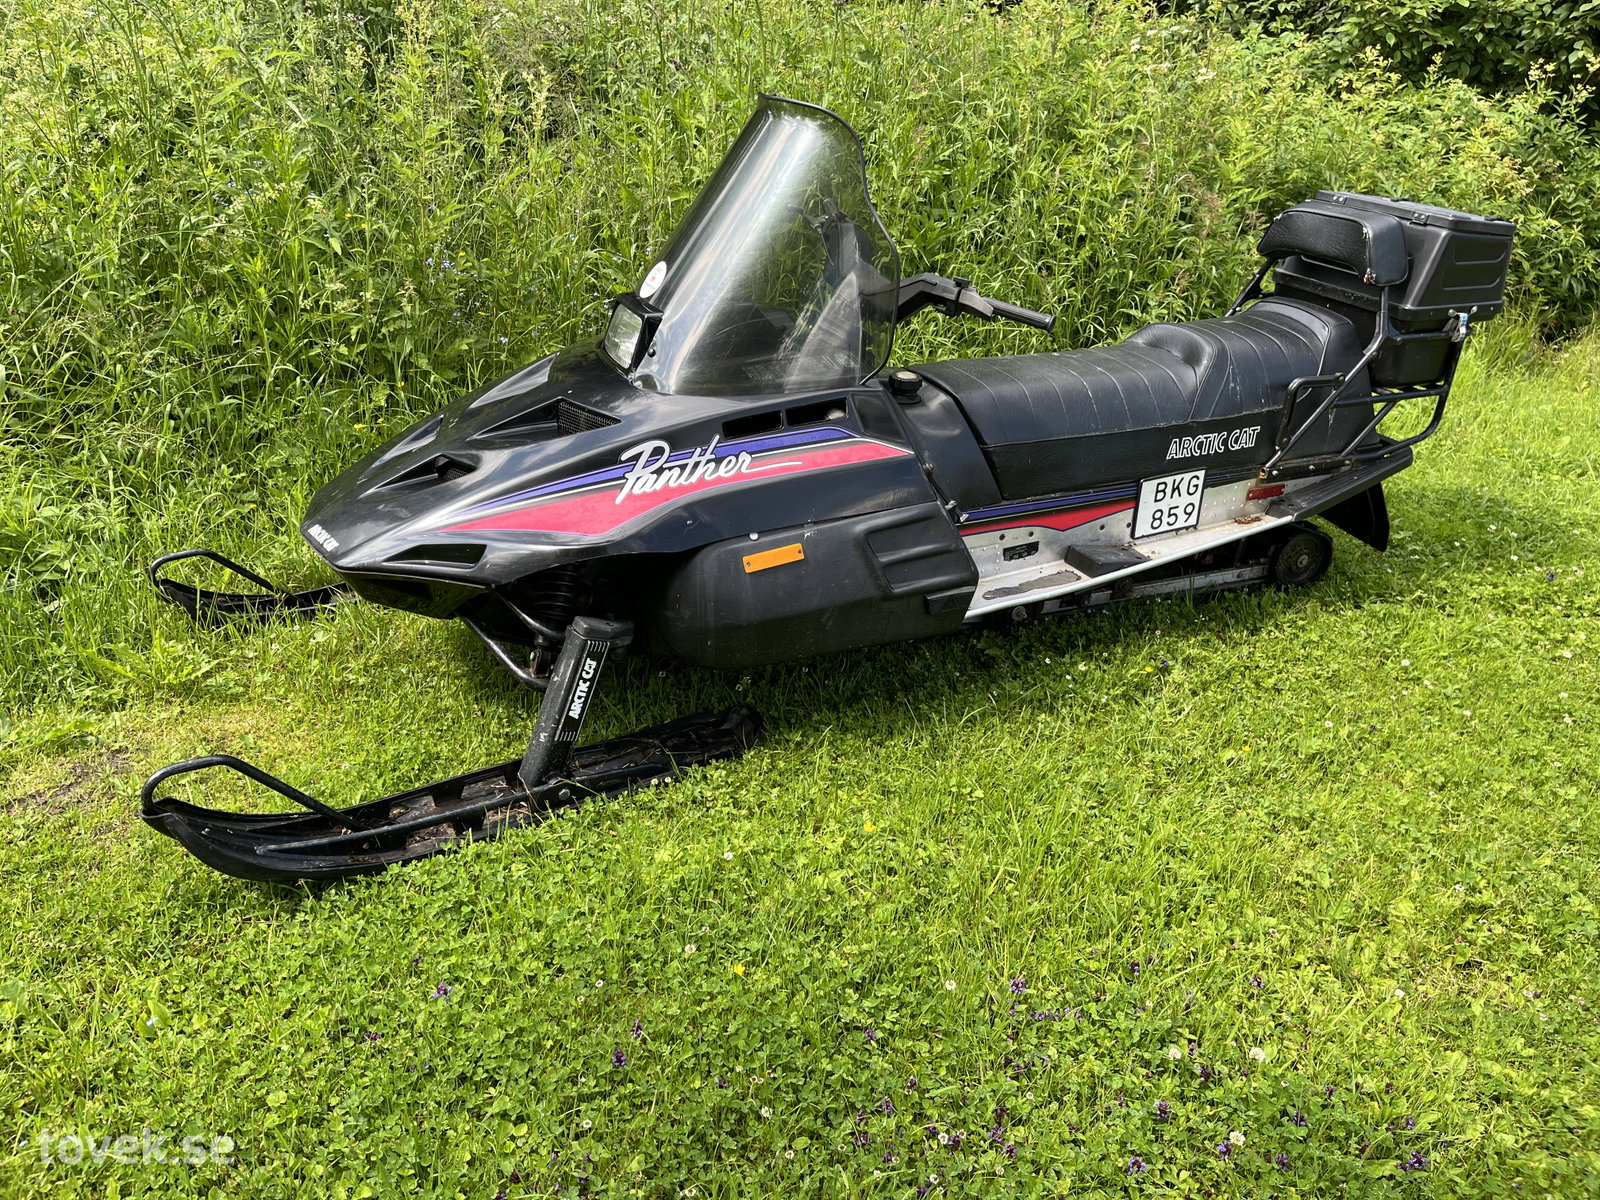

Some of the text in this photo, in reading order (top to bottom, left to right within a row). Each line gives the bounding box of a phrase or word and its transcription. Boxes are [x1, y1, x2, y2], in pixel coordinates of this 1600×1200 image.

[1166, 426, 1261, 460] ARCTIC CAT
[614, 433, 803, 505] Panther
[1153, 475, 1200, 503] BKG
[1150, 502, 1196, 530] 859
[568, 657, 598, 720] ARCTIC CAT
